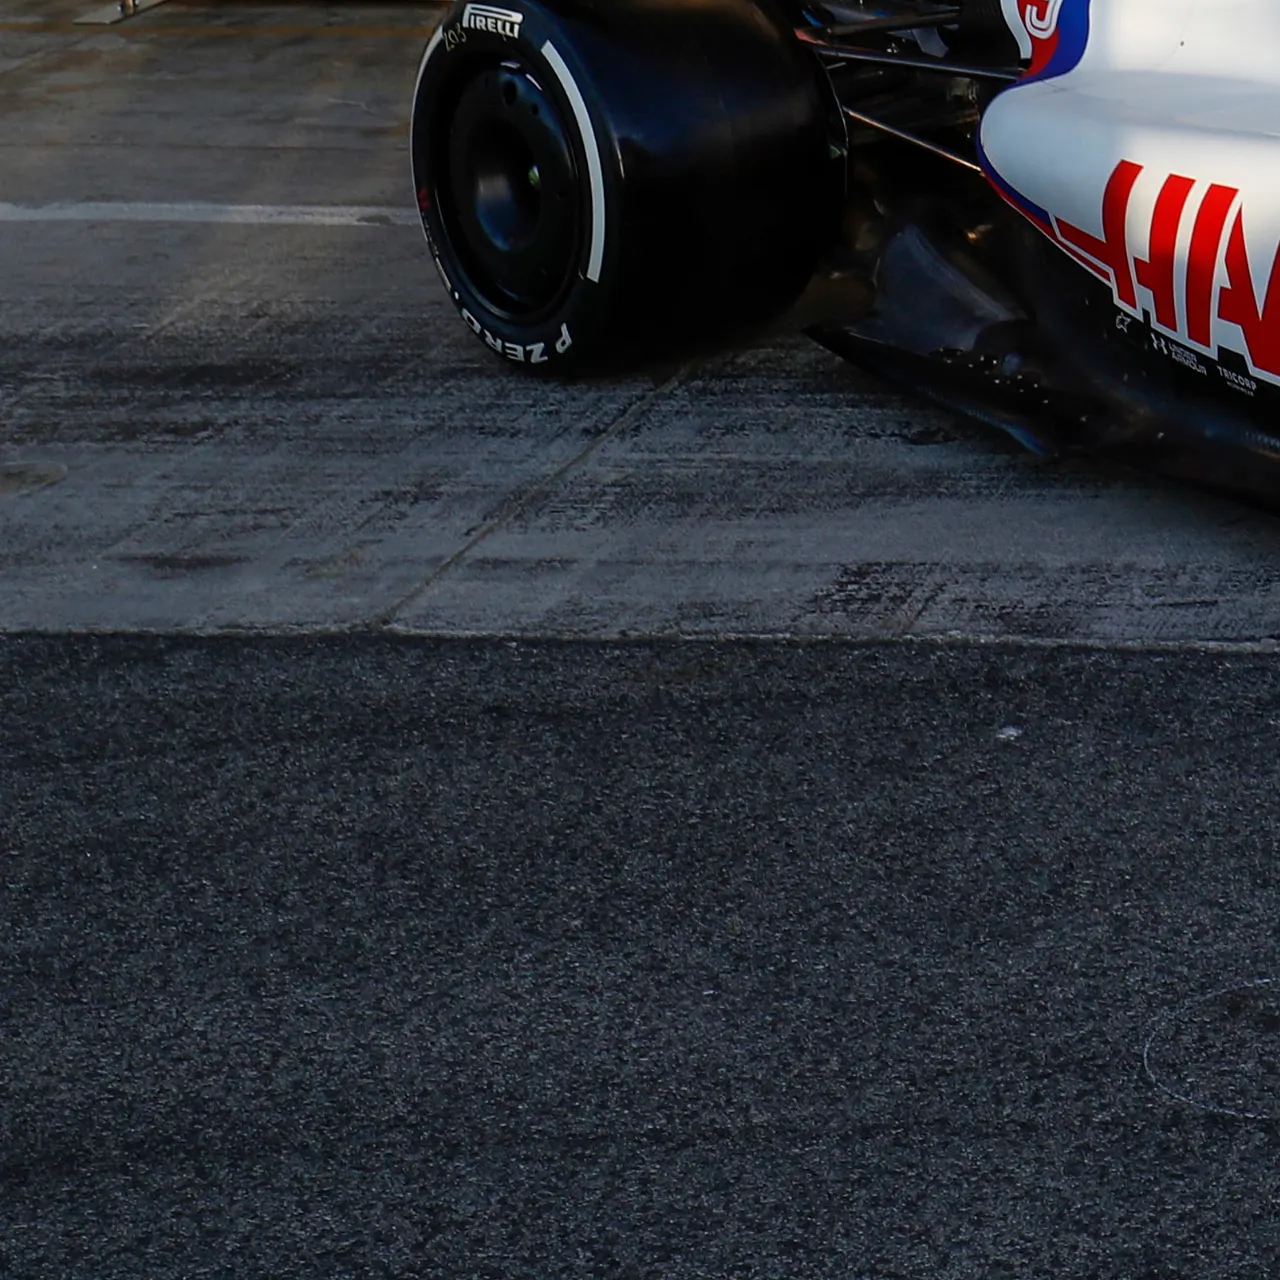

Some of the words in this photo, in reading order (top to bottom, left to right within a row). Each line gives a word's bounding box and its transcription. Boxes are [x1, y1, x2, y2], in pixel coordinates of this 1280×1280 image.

[462, 3, 524, 38] PIRELLI
[460, 307, 549, 364] ZERO
[1216, 365, 1258, 391] TRICORP
